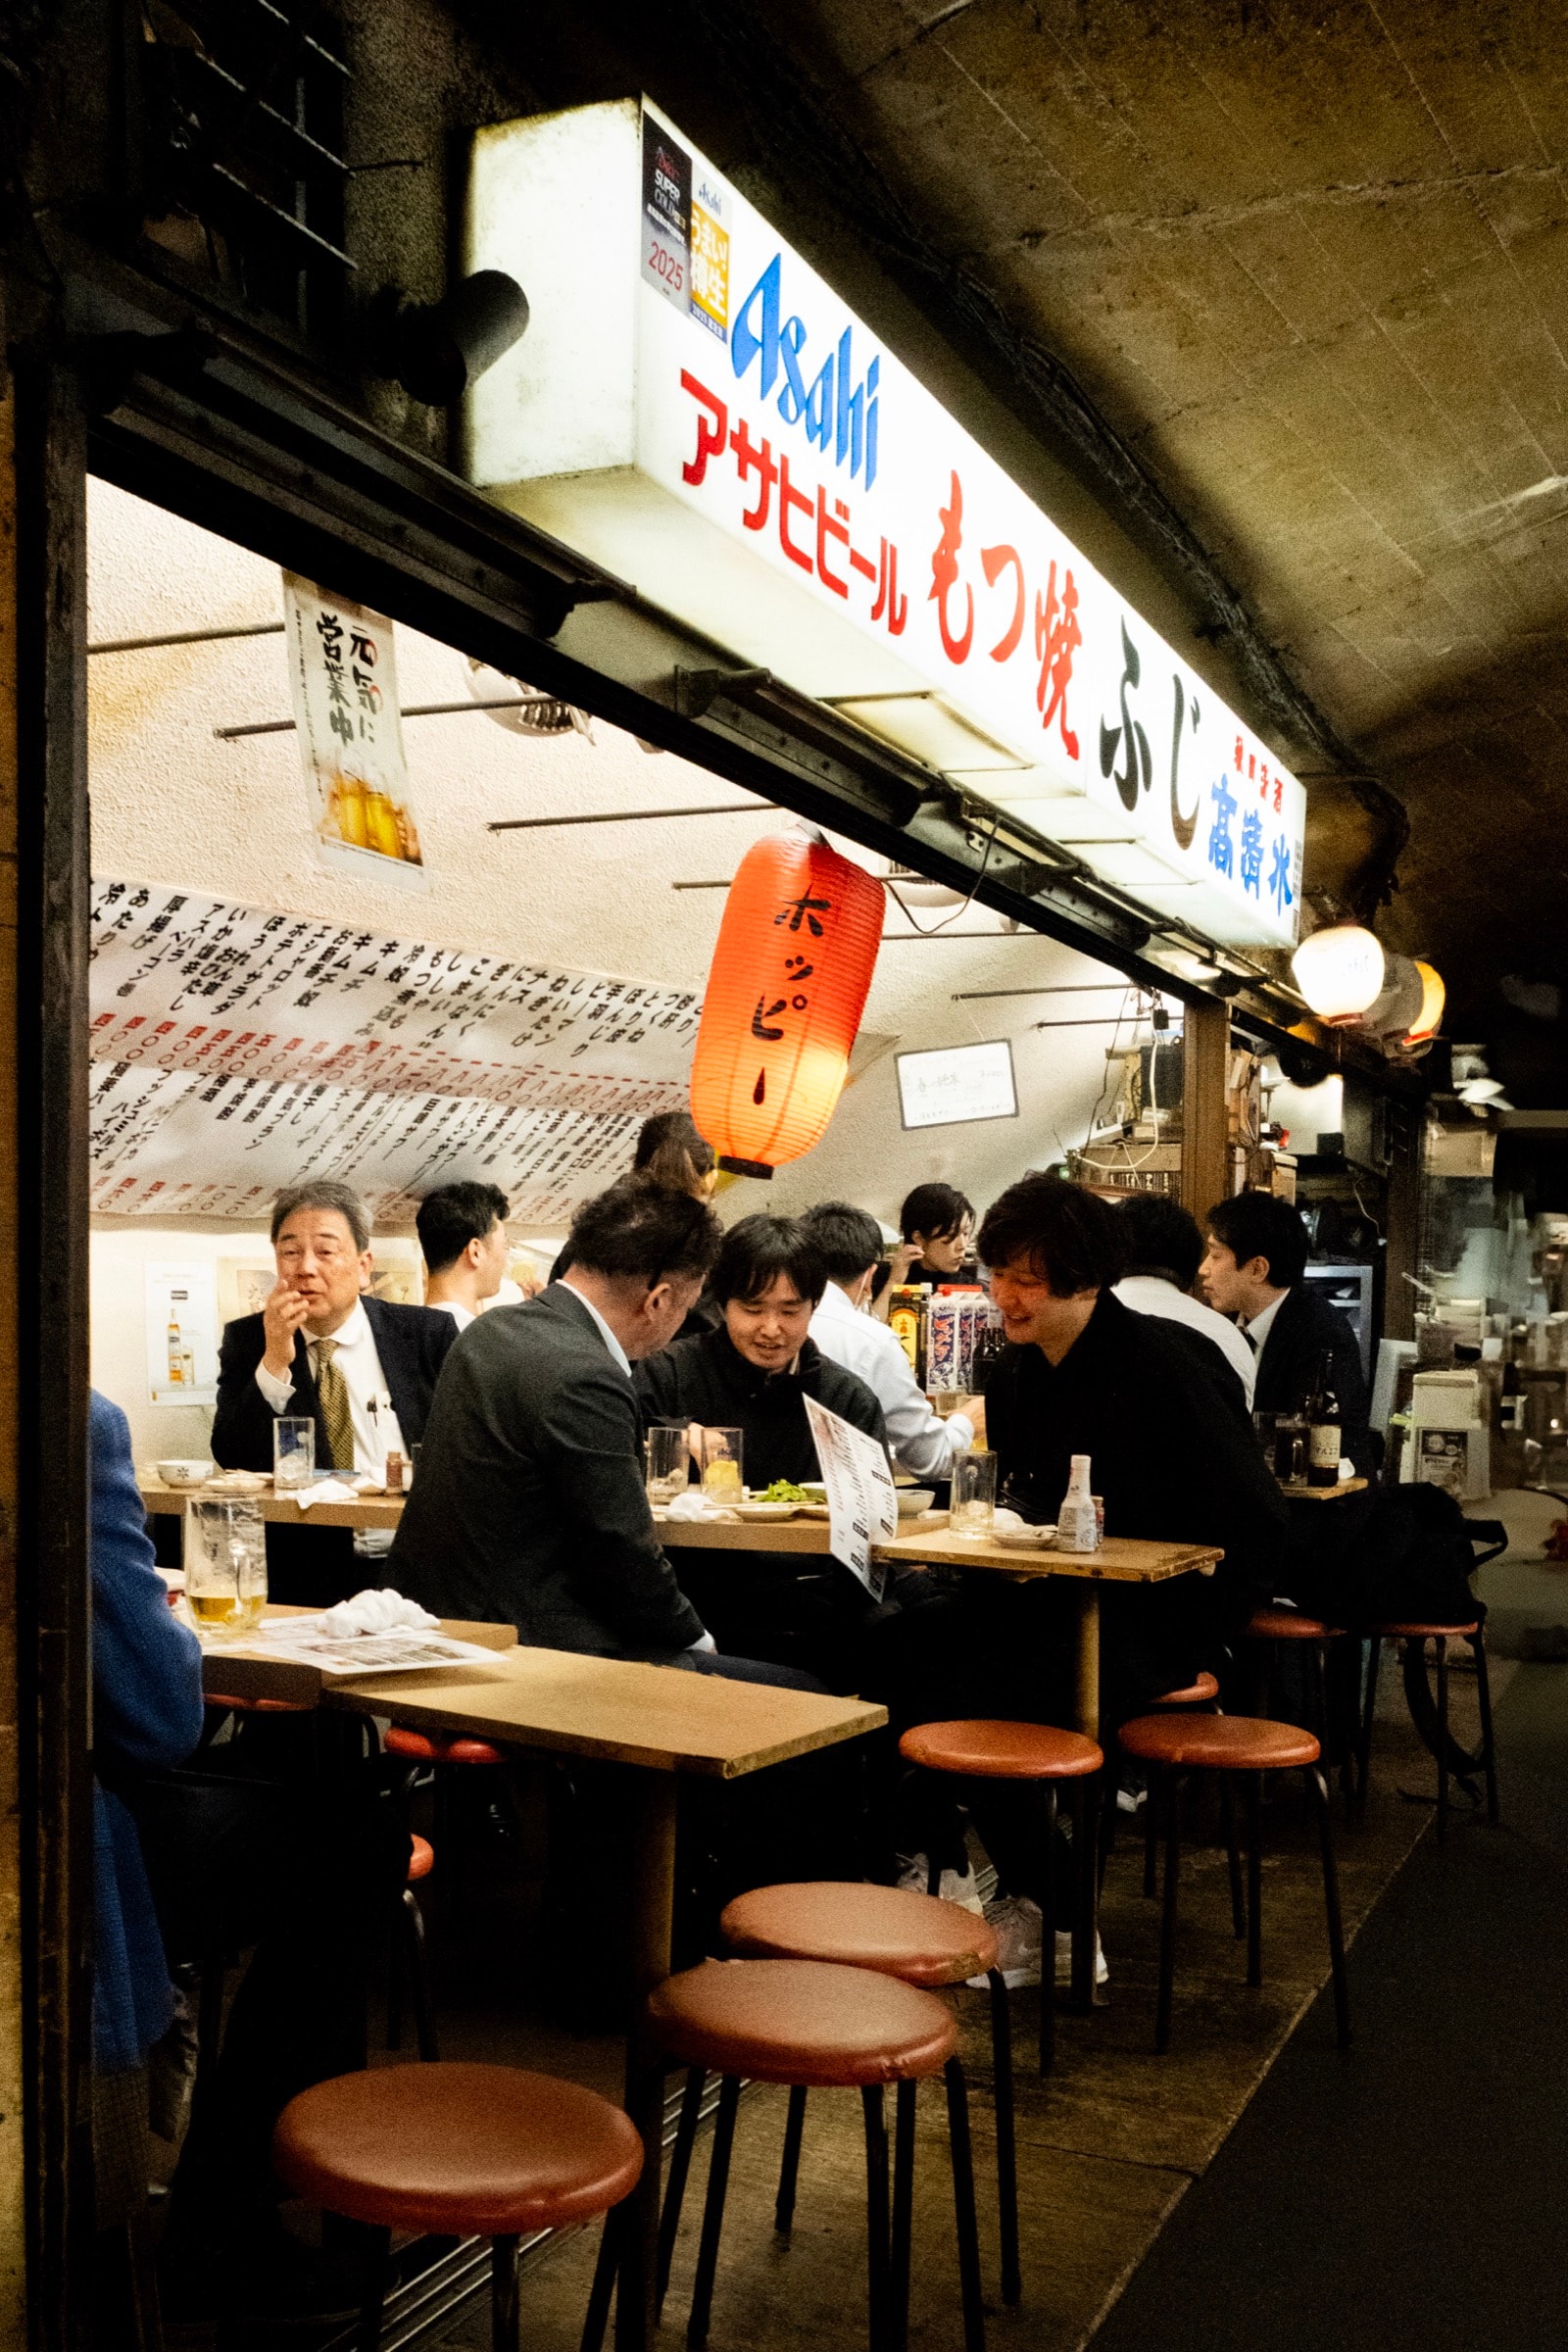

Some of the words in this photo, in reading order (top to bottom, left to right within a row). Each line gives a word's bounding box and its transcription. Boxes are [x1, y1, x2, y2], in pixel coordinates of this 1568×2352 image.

[655, 170, 680, 207] SUPER
[699, 182, 722, 216] Asahi
[648, 241, 684, 292] 2025
[732, 252, 880, 492] Asahi
[680, 368, 908, 636] アサヒビール
[927, 469, 1082, 761] もつ焼
[317, 612, 355, 747] 営業中
[1100, 615, 1201, 851] ふじ
[1208, 773, 1293, 917] 高清水
[182, 909, 245, 974] いか塩辛
[201, 916, 285, 996] ほうれん草
[249, 926, 330, 1007] エシャロット
[296, 935, 370, 1006] キムチ奴
[342, 942, 398, 991] キムチ
[170, 948, 237, 1011] おひたし
[390, 953, 461, 1029] ししゃも
[431, 958, 489, 1011] こまい
[461, 967, 531, 1035] にんにく
[510, 971, 547, 1004] ナス
[513, 981, 582, 1047] しいたけ
[528, 976, 567, 1011] ねぎ
[535, 982, 612, 1046] ピーマン
[751, 883, 832, 1105] ホッピー
[434, 1103, 494, 1174] レモンサワー
